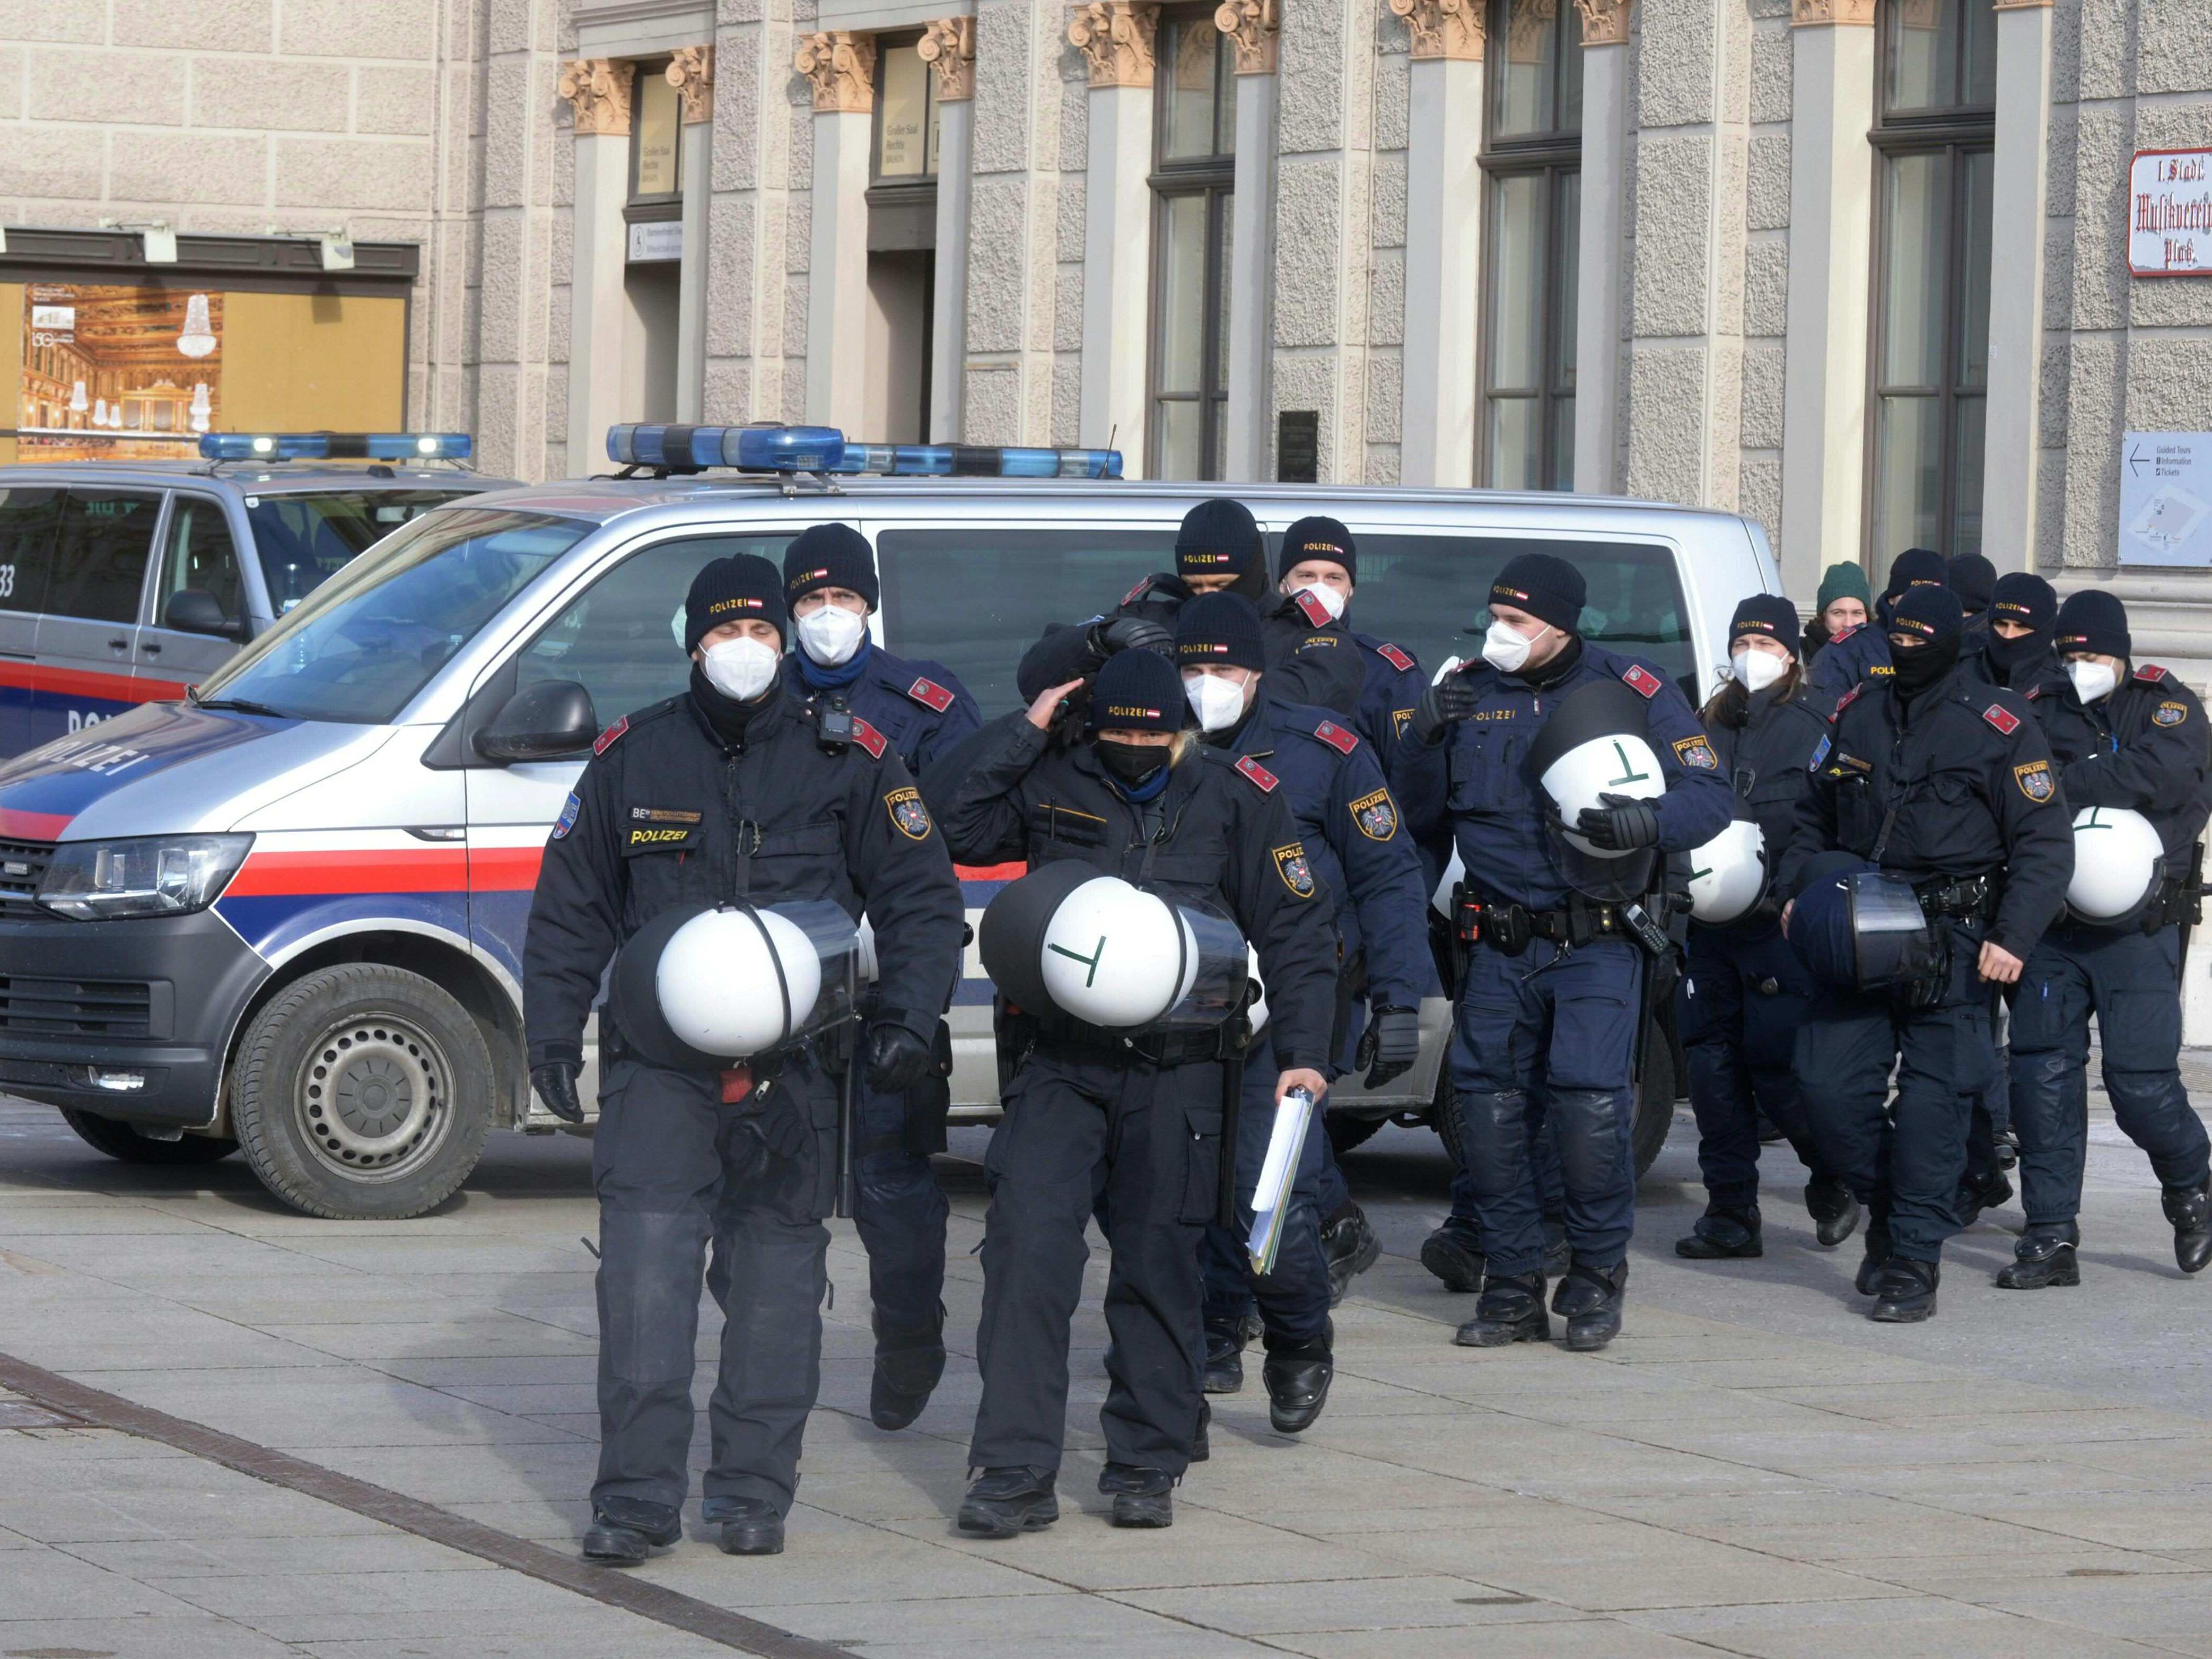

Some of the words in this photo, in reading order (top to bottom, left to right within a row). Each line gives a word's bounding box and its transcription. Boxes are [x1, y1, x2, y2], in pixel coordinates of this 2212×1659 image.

[1304, 543, 1334, 552] POLIZEI
[1184, 554, 1216, 563] POLIZEI
[710, 598, 747, 614] POLIZEI
[1996, 603, 2020, 611] POLIZEI
[1896, 617, 1924, 630] POLIZEI
[1179, 643, 1212, 653] POLIZEI
[1870, 666, 1895, 675] POLI
[1108, 706, 1146, 717] POLIZEI
[633, 808, 646, 818] BE
[631, 830, 688, 844] POLIZEI
